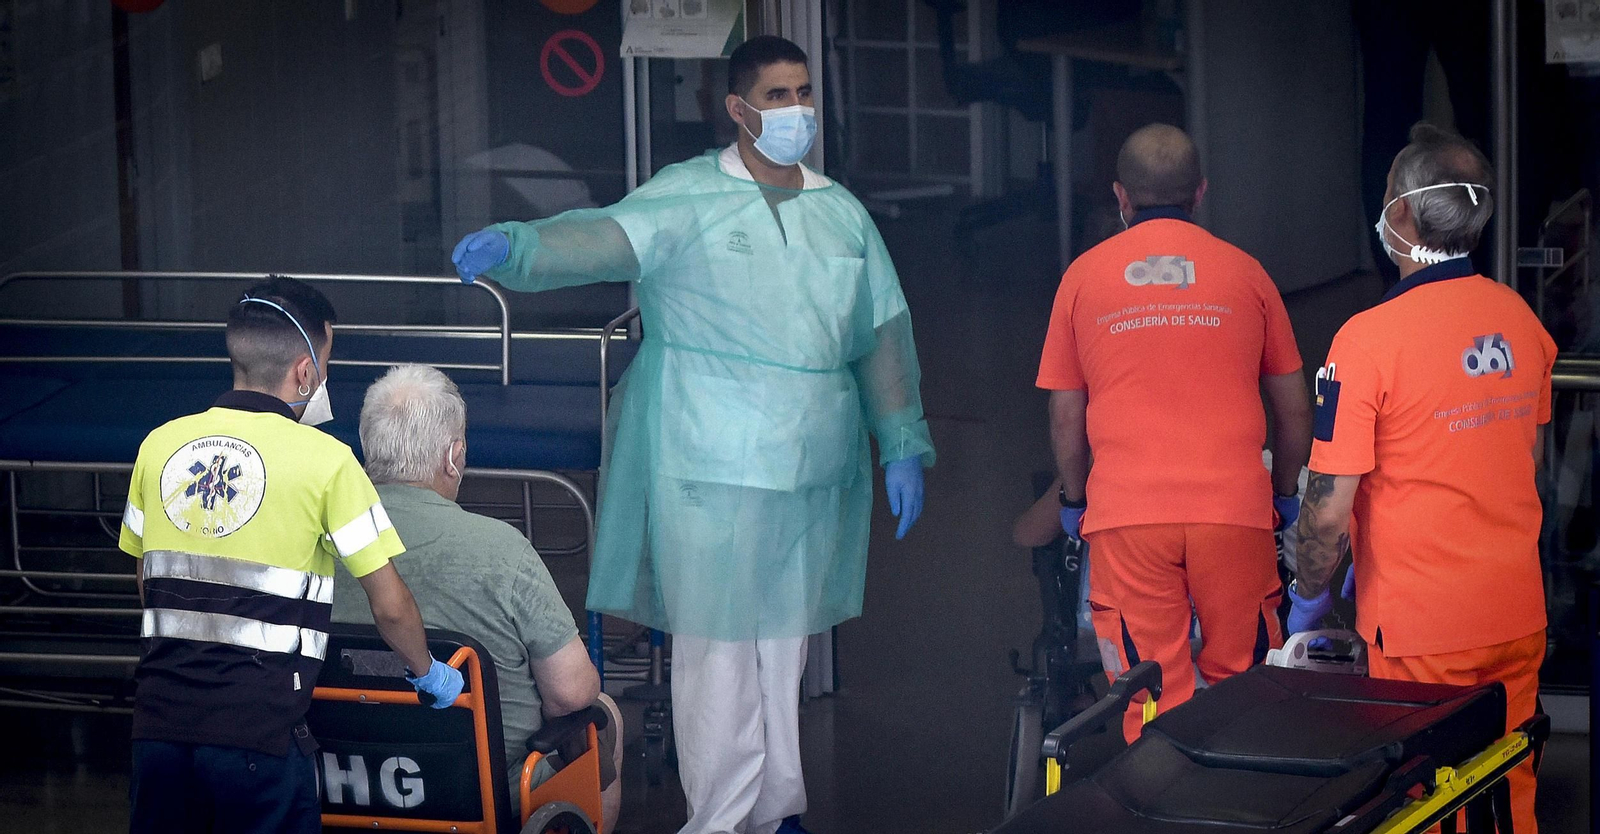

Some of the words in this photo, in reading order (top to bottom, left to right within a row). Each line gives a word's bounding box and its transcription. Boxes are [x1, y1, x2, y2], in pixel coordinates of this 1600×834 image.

[1124, 255, 1196, 289] 061
[1096, 311, 1121, 326] Empresa
[1147, 303, 1157, 311] de
[1158, 303, 1202, 312] Emergencias
[1110, 313, 1169, 335] CONSEJERÍA
[1171, 315, 1186, 327] DE
[1188, 314, 1221, 328] SALUD
[192, 440, 252, 458] AMBULANCIAS
